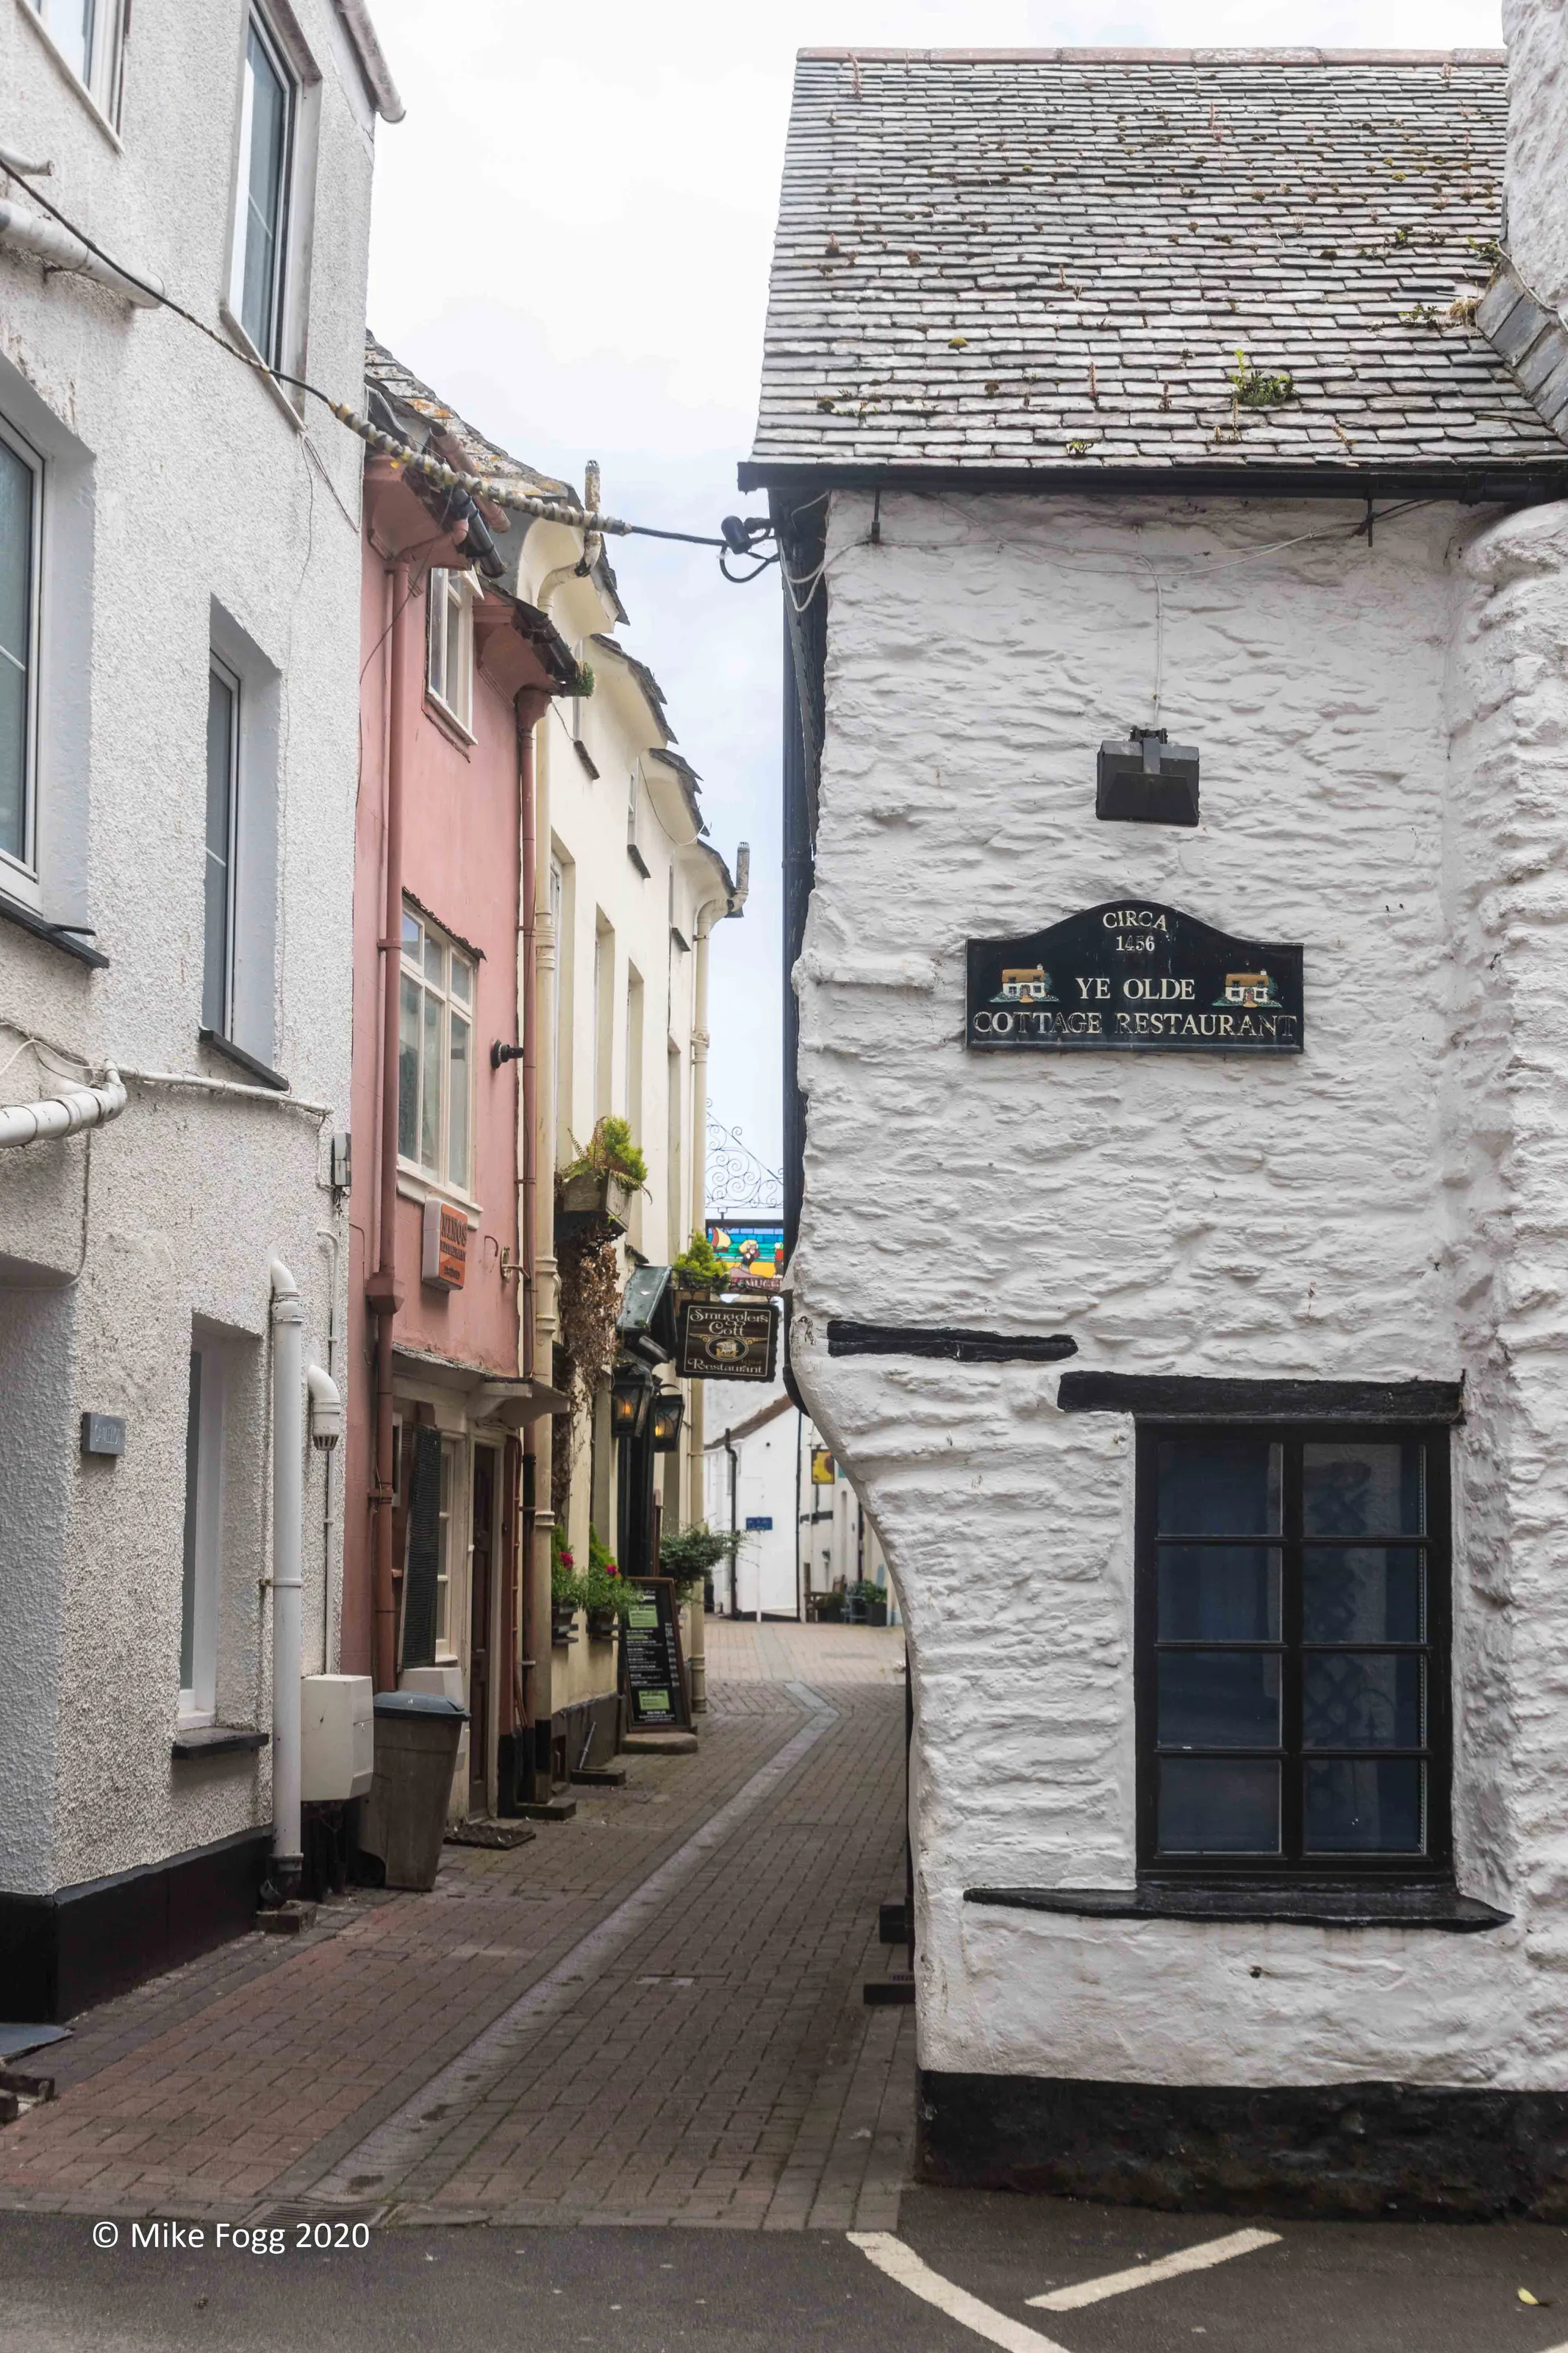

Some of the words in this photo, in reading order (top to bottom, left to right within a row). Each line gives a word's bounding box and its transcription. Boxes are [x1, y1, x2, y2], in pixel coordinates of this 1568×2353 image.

[1103, 910, 1167, 932] CIRCA
[1116, 935, 1155, 952] 1456
[1075, 977, 1111, 1000] YE
[1123, 978, 1195, 1001] OLDE
[973, 1011, 1103, 1035] COTTAGE
[1114, 1013, 1297, 1038] RESTAURANT
[709, 1321, 745, 1337] Cott
[687, 1357, 762, 1374] Restaurant
